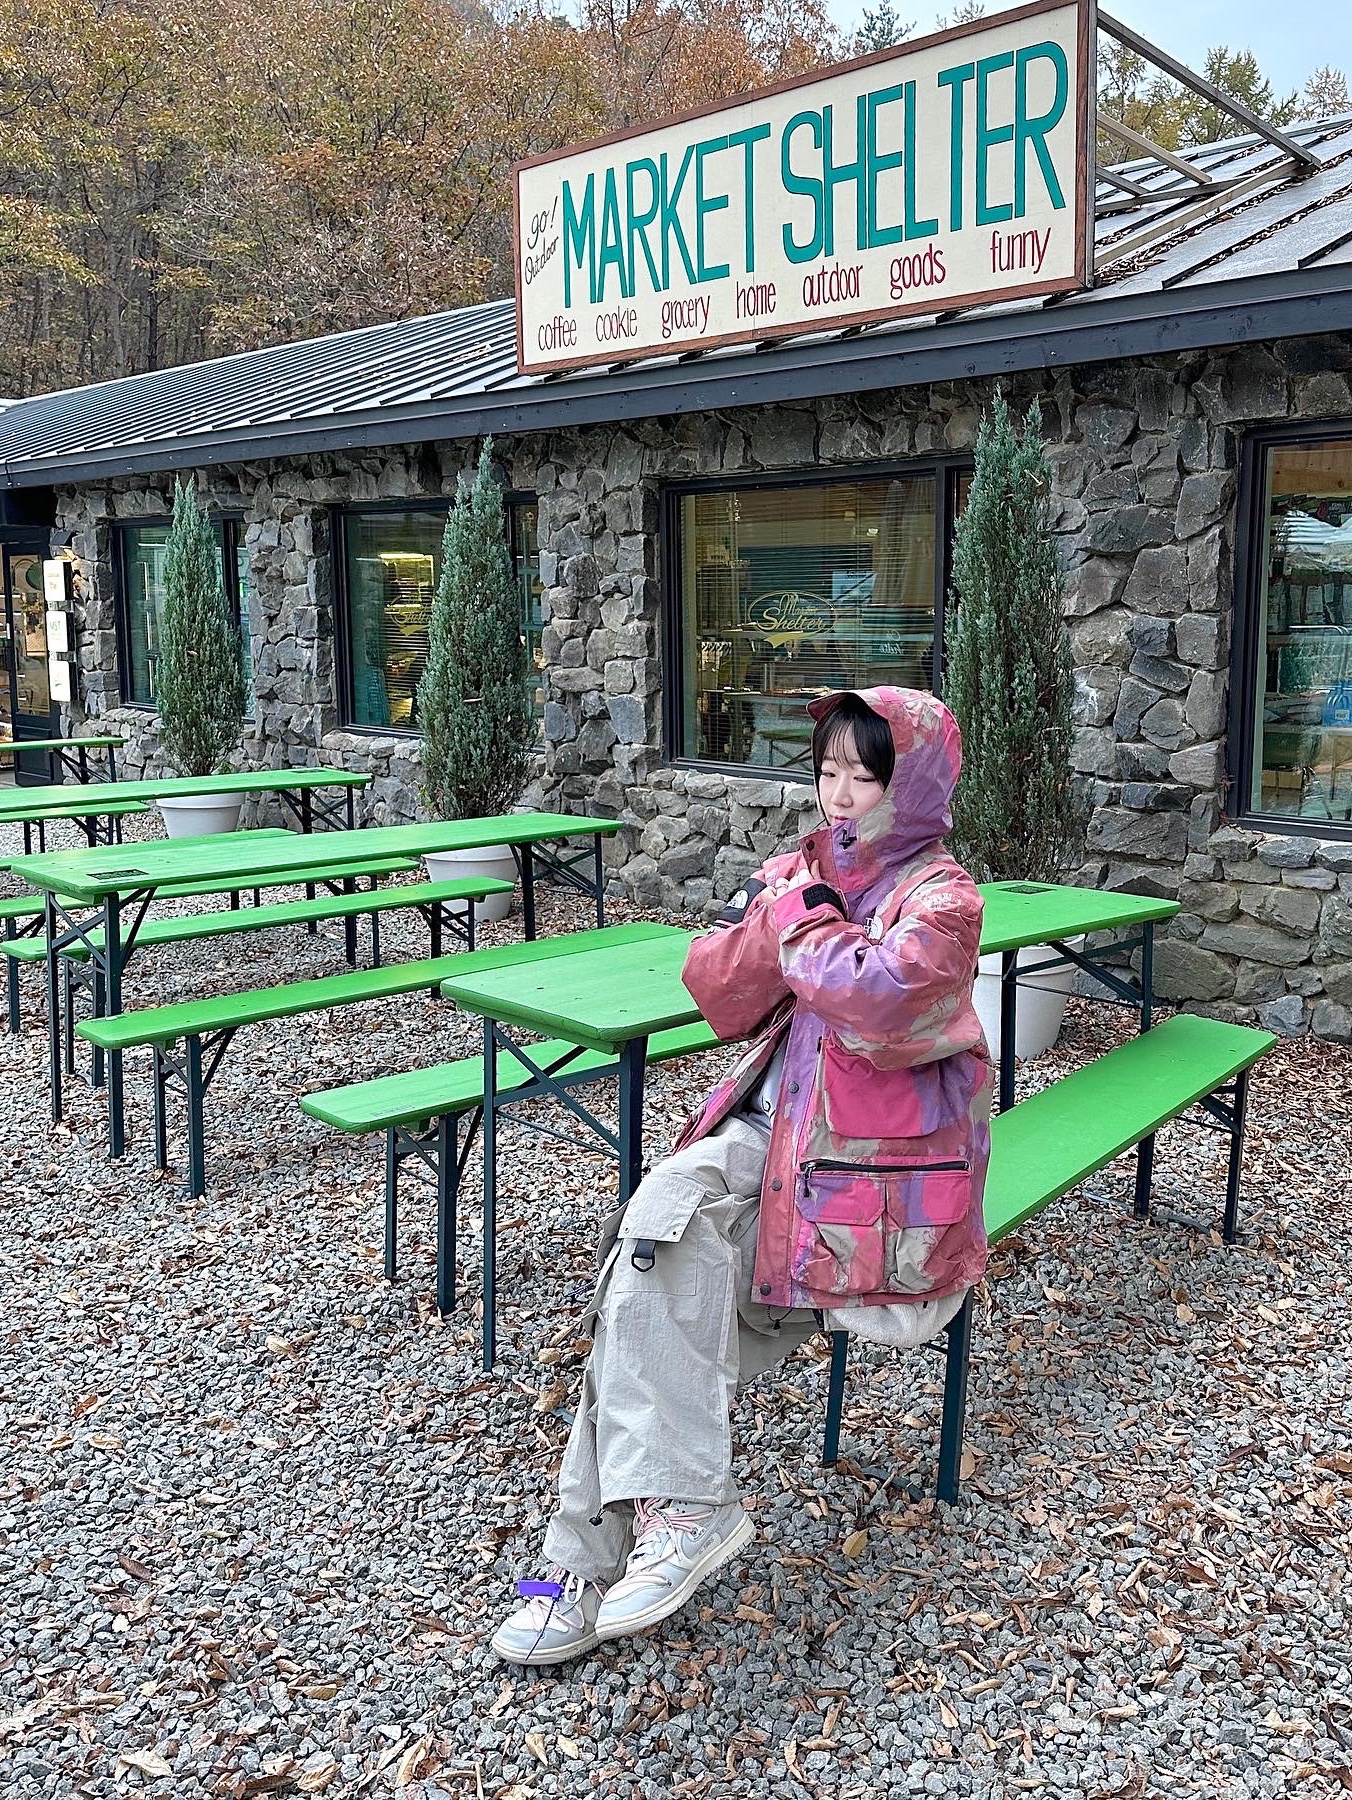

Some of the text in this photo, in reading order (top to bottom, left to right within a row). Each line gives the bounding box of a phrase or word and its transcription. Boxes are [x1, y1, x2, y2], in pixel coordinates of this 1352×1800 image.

[562, 40, 1067, 308] MARKET SHELTER
[526, 195, 558, 249] go!
[524, 236, 559, 285] Outdoor
[537, 226, 1052, 351] coffee cookie grocery home outdoor goods funny
[758, 606, 826, 631] Shelter
